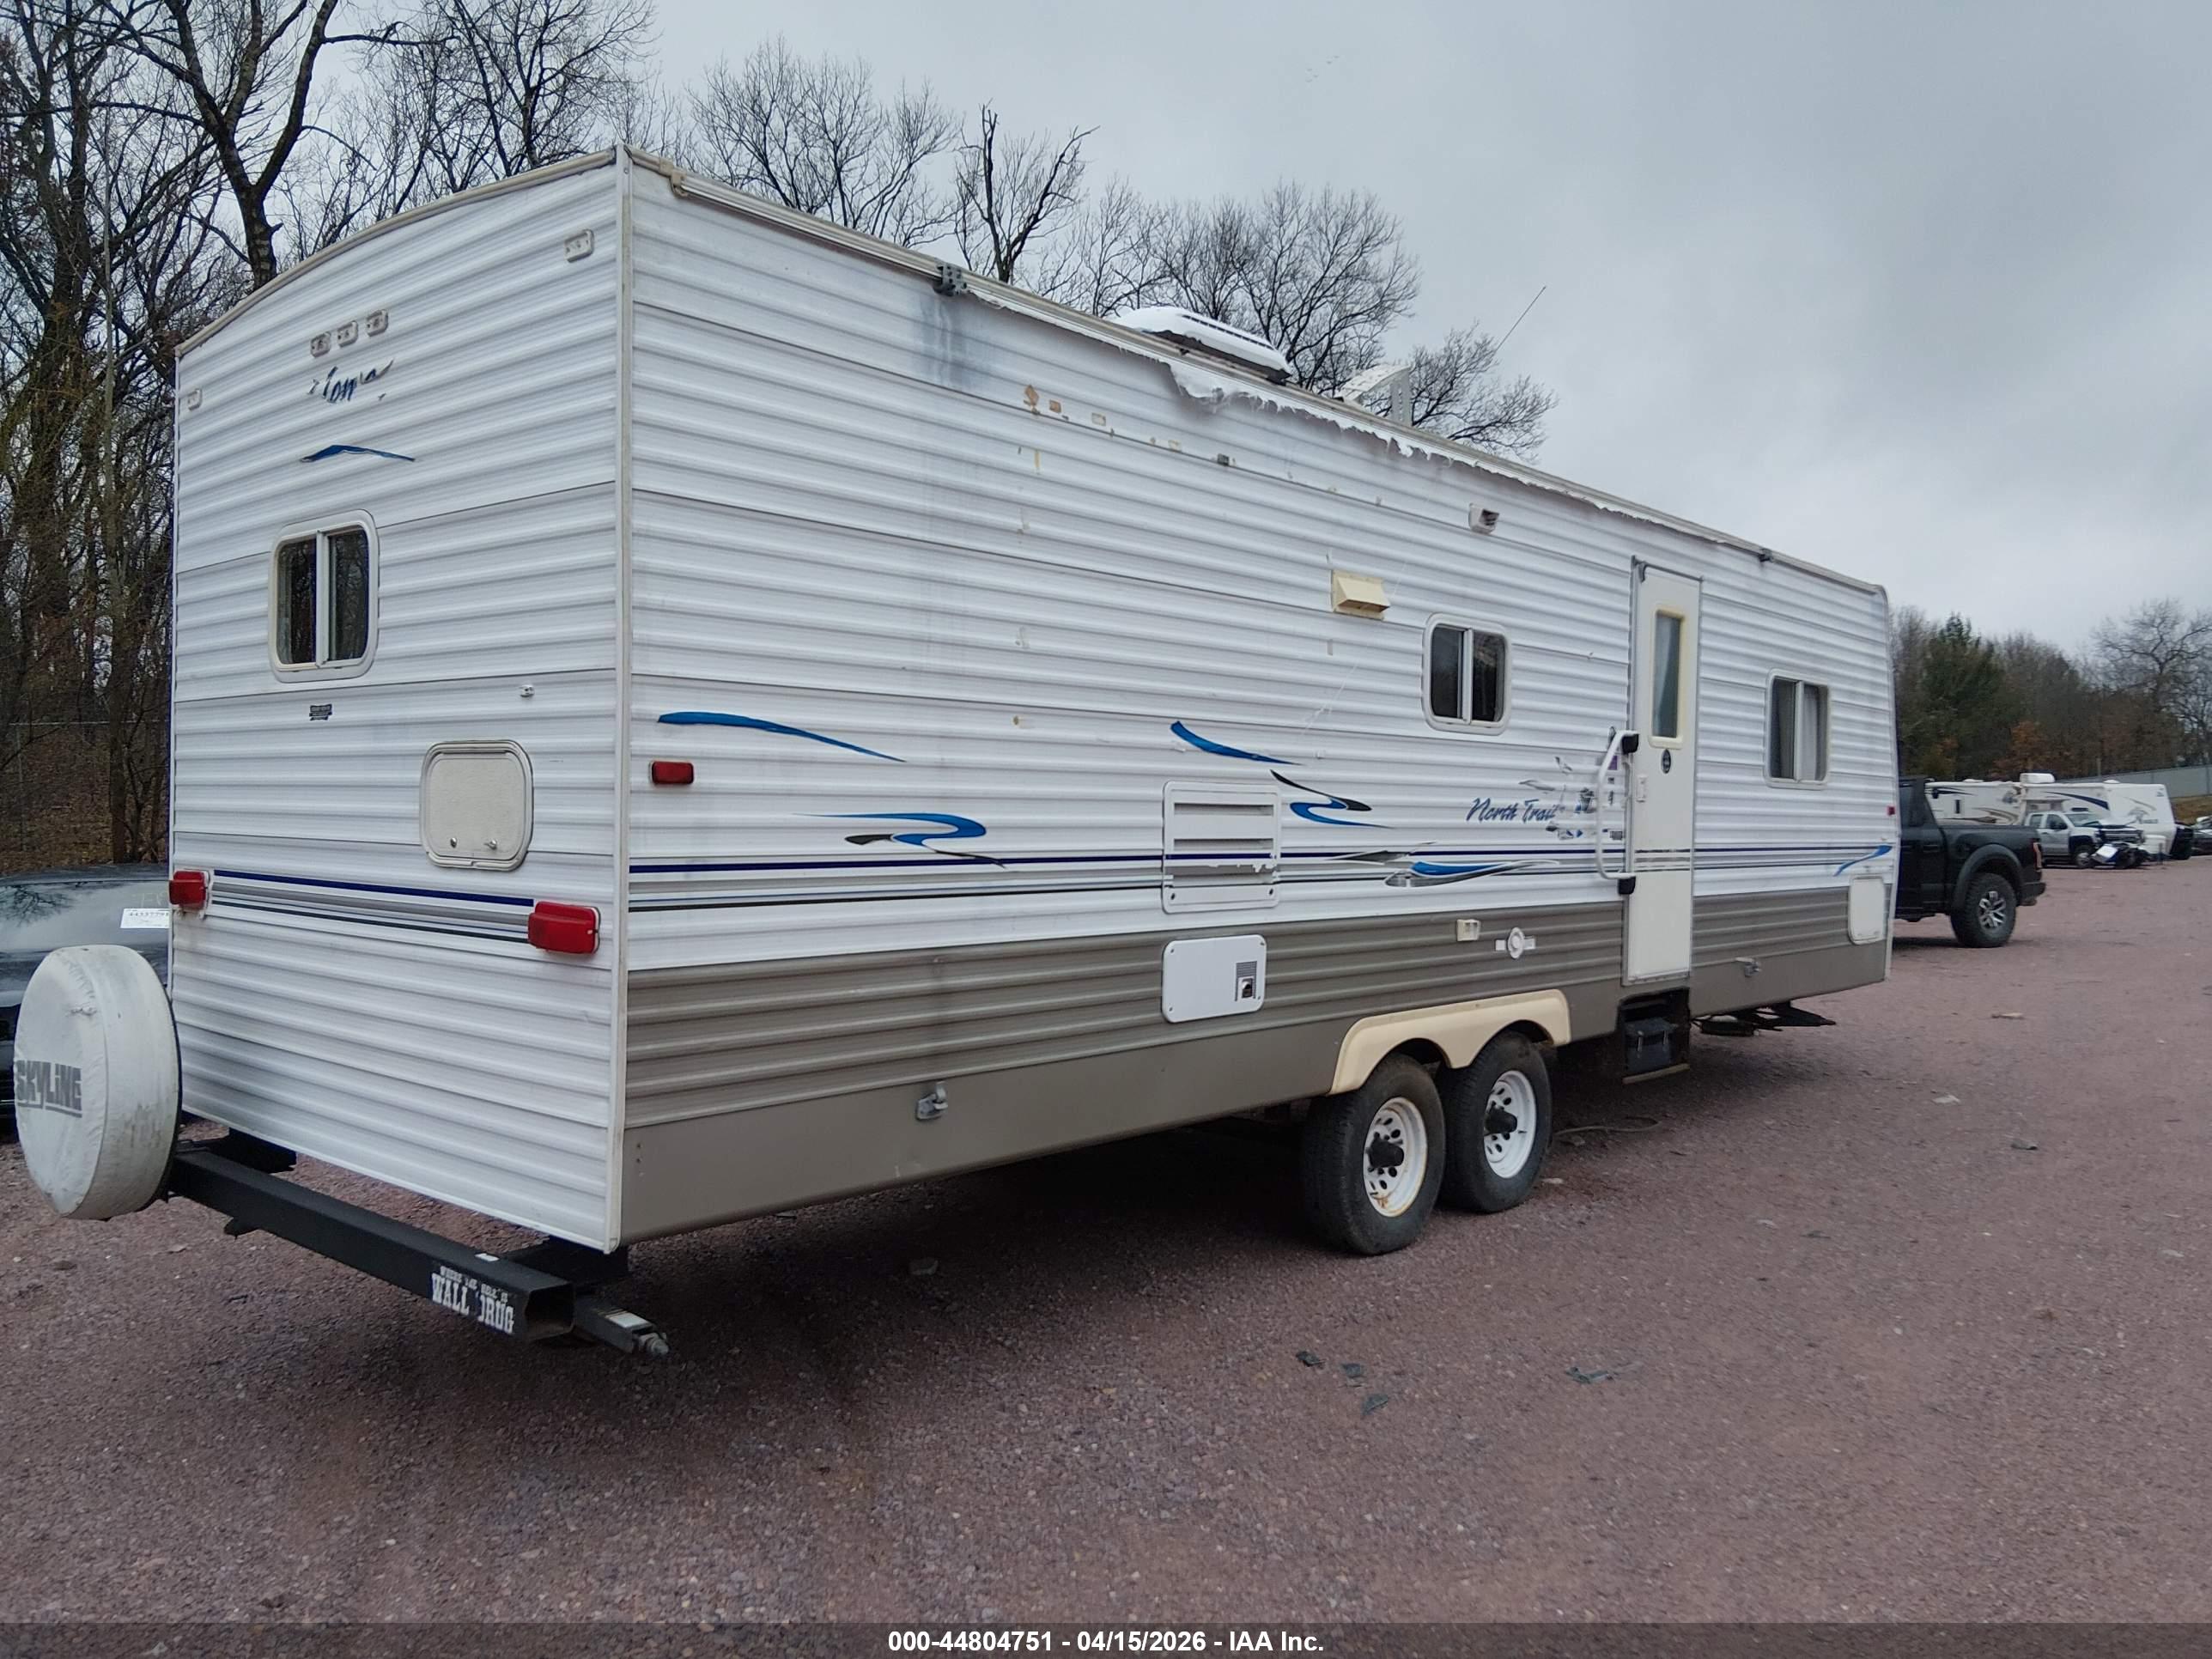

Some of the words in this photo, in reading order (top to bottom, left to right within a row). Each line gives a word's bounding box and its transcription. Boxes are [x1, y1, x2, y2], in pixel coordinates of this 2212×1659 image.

[1465, 797, 1518, 822] North
[1522, 798, 1559, 823] Trail
[16, 1060, 82, 1116] SKYLINE
[432, 1273, 470, 1316] WALL
